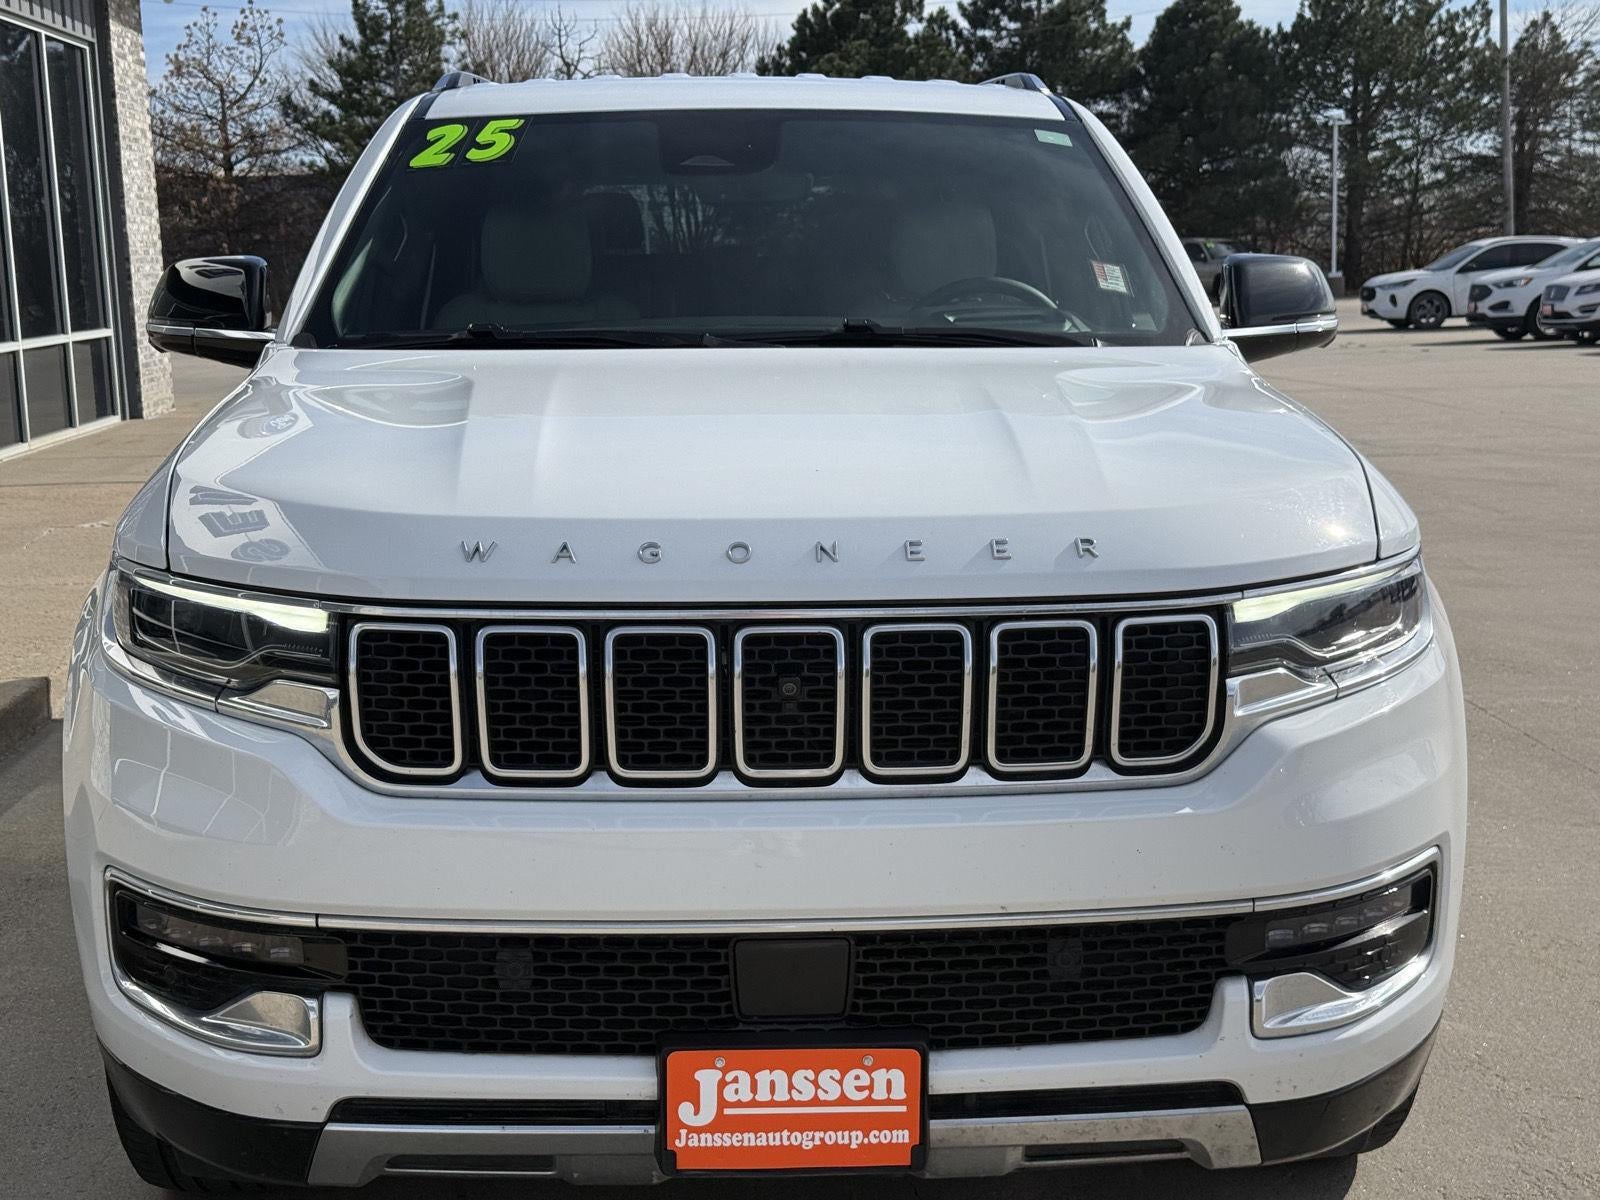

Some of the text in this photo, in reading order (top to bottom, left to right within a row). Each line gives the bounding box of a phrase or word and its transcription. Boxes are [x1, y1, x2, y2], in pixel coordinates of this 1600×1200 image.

[409, 119, 525, 169] 25
[461, 537, 1100, 564] WAGONEER
[677, 1067, 907, 1127] Janssen
[675, 1128, 909, 1149] Janssenautogroup.com
